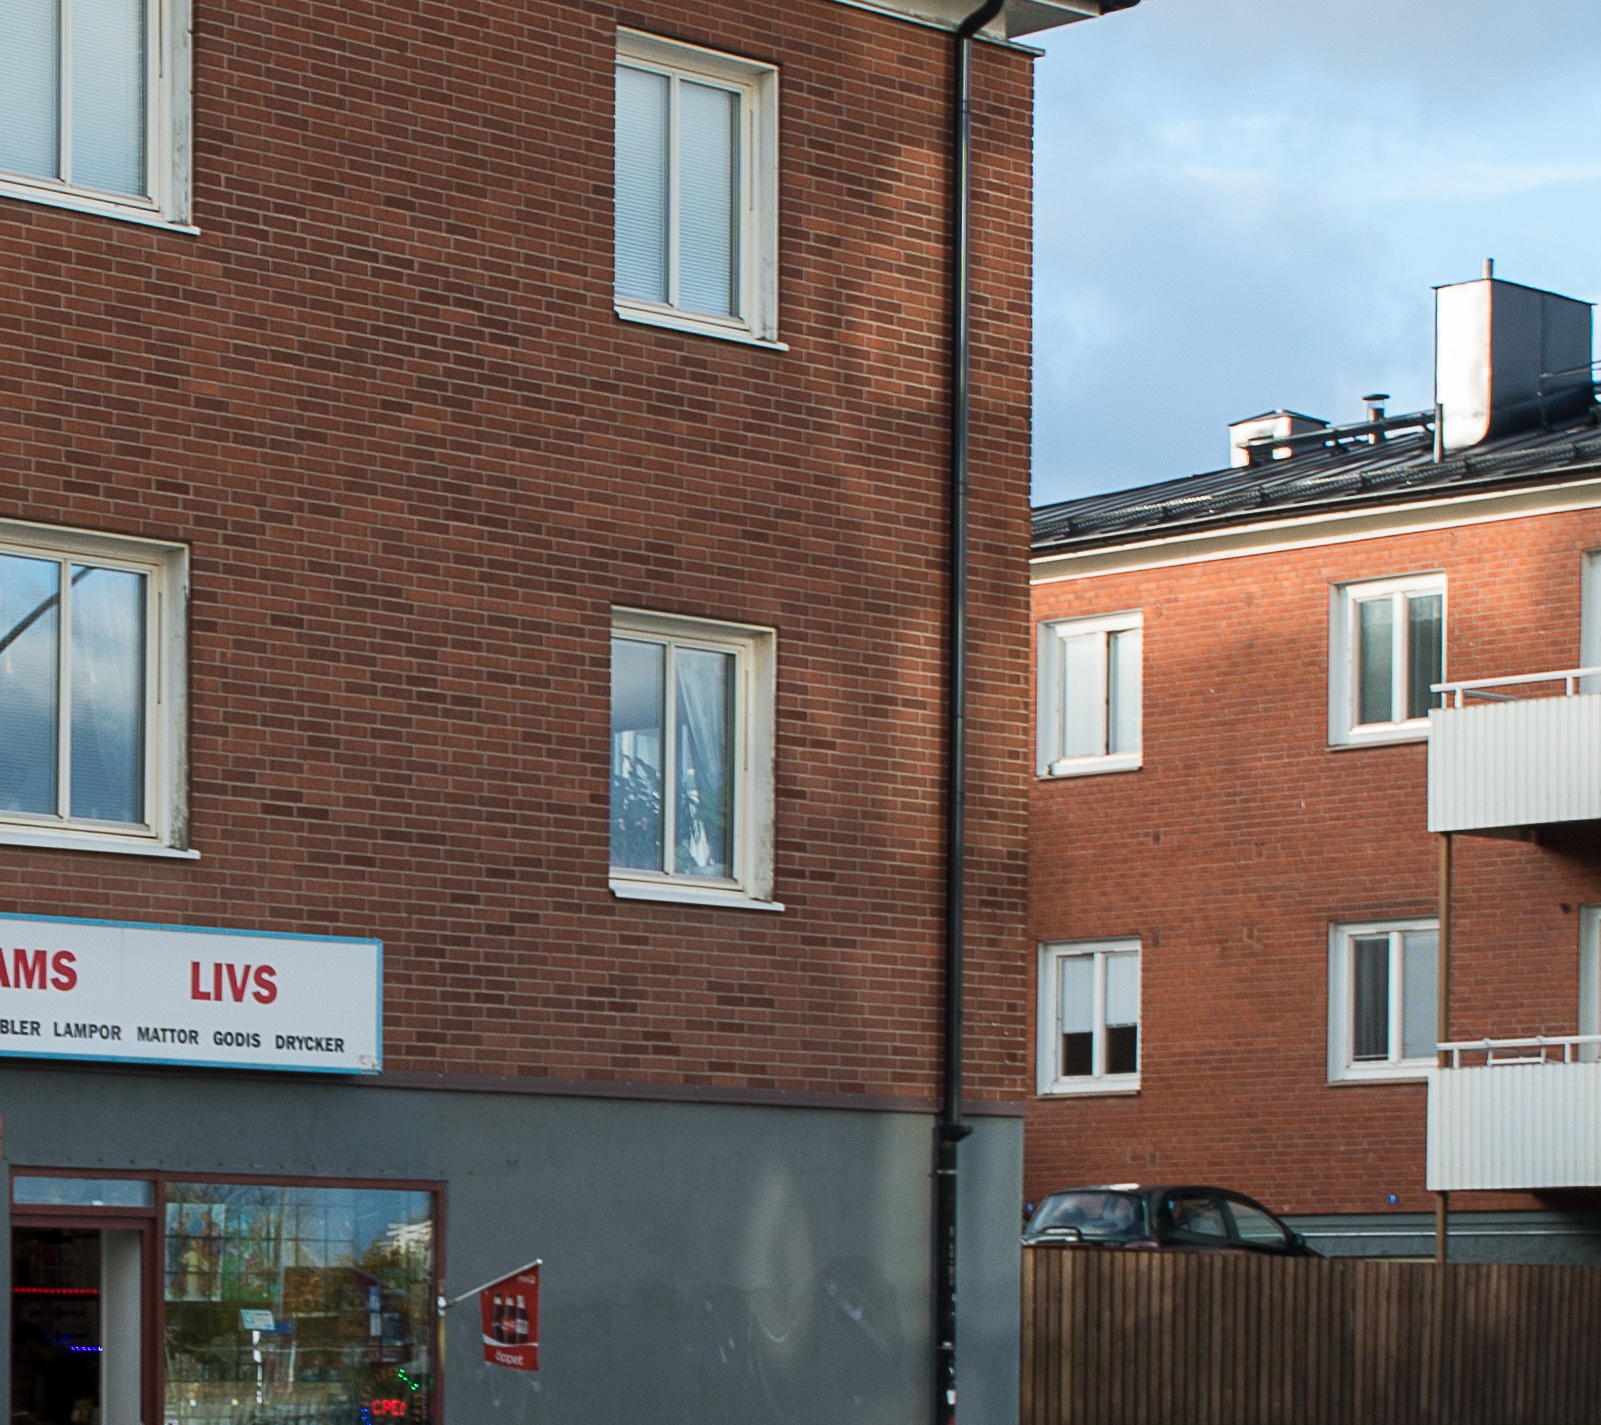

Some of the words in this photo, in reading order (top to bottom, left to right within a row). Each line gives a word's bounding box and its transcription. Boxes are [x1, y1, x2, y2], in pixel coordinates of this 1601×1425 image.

[190, 960, 278, 1005] LIVS
[53, 1021, 122, 1041] LAMPOR
[137, 1026, 199, 1045] MATTOR
[213, 1030, 261, 1049] GODIS
[275, 1034, 345, 1053] DRYCKER
